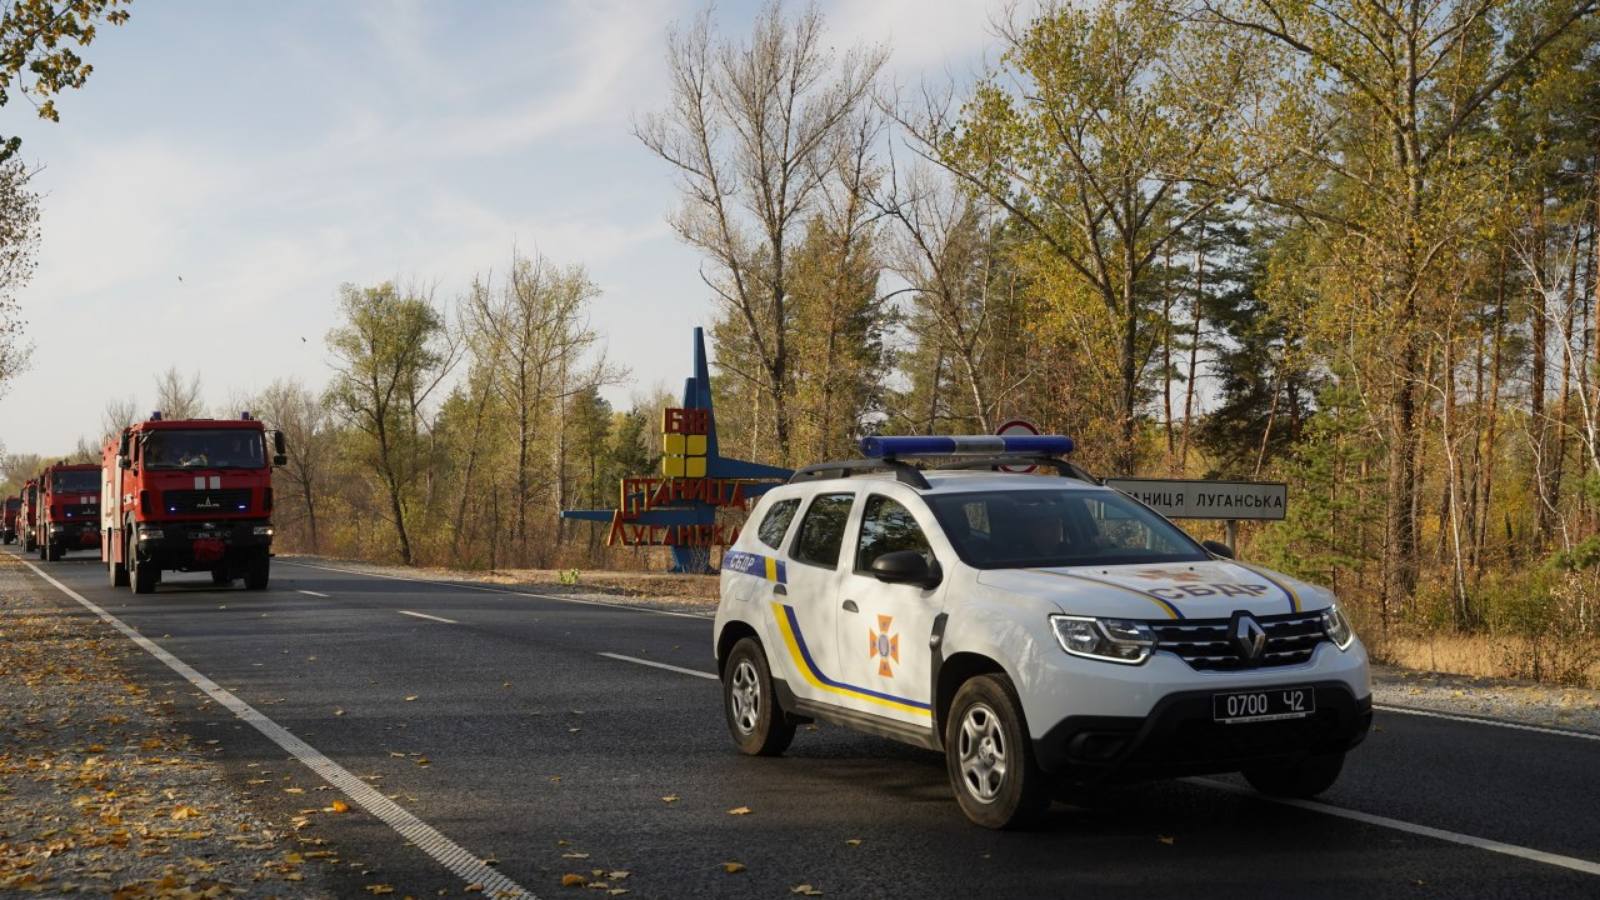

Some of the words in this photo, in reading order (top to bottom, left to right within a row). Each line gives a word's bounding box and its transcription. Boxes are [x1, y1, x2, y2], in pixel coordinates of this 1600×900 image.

[1196, 493, 1282, 509] ЛУГАНСЬКА
[729, 553, 755, 572] СБДР
[1148, 583, 1268, 600] СБДР
[1227, 693, 1268, 716] 0700
